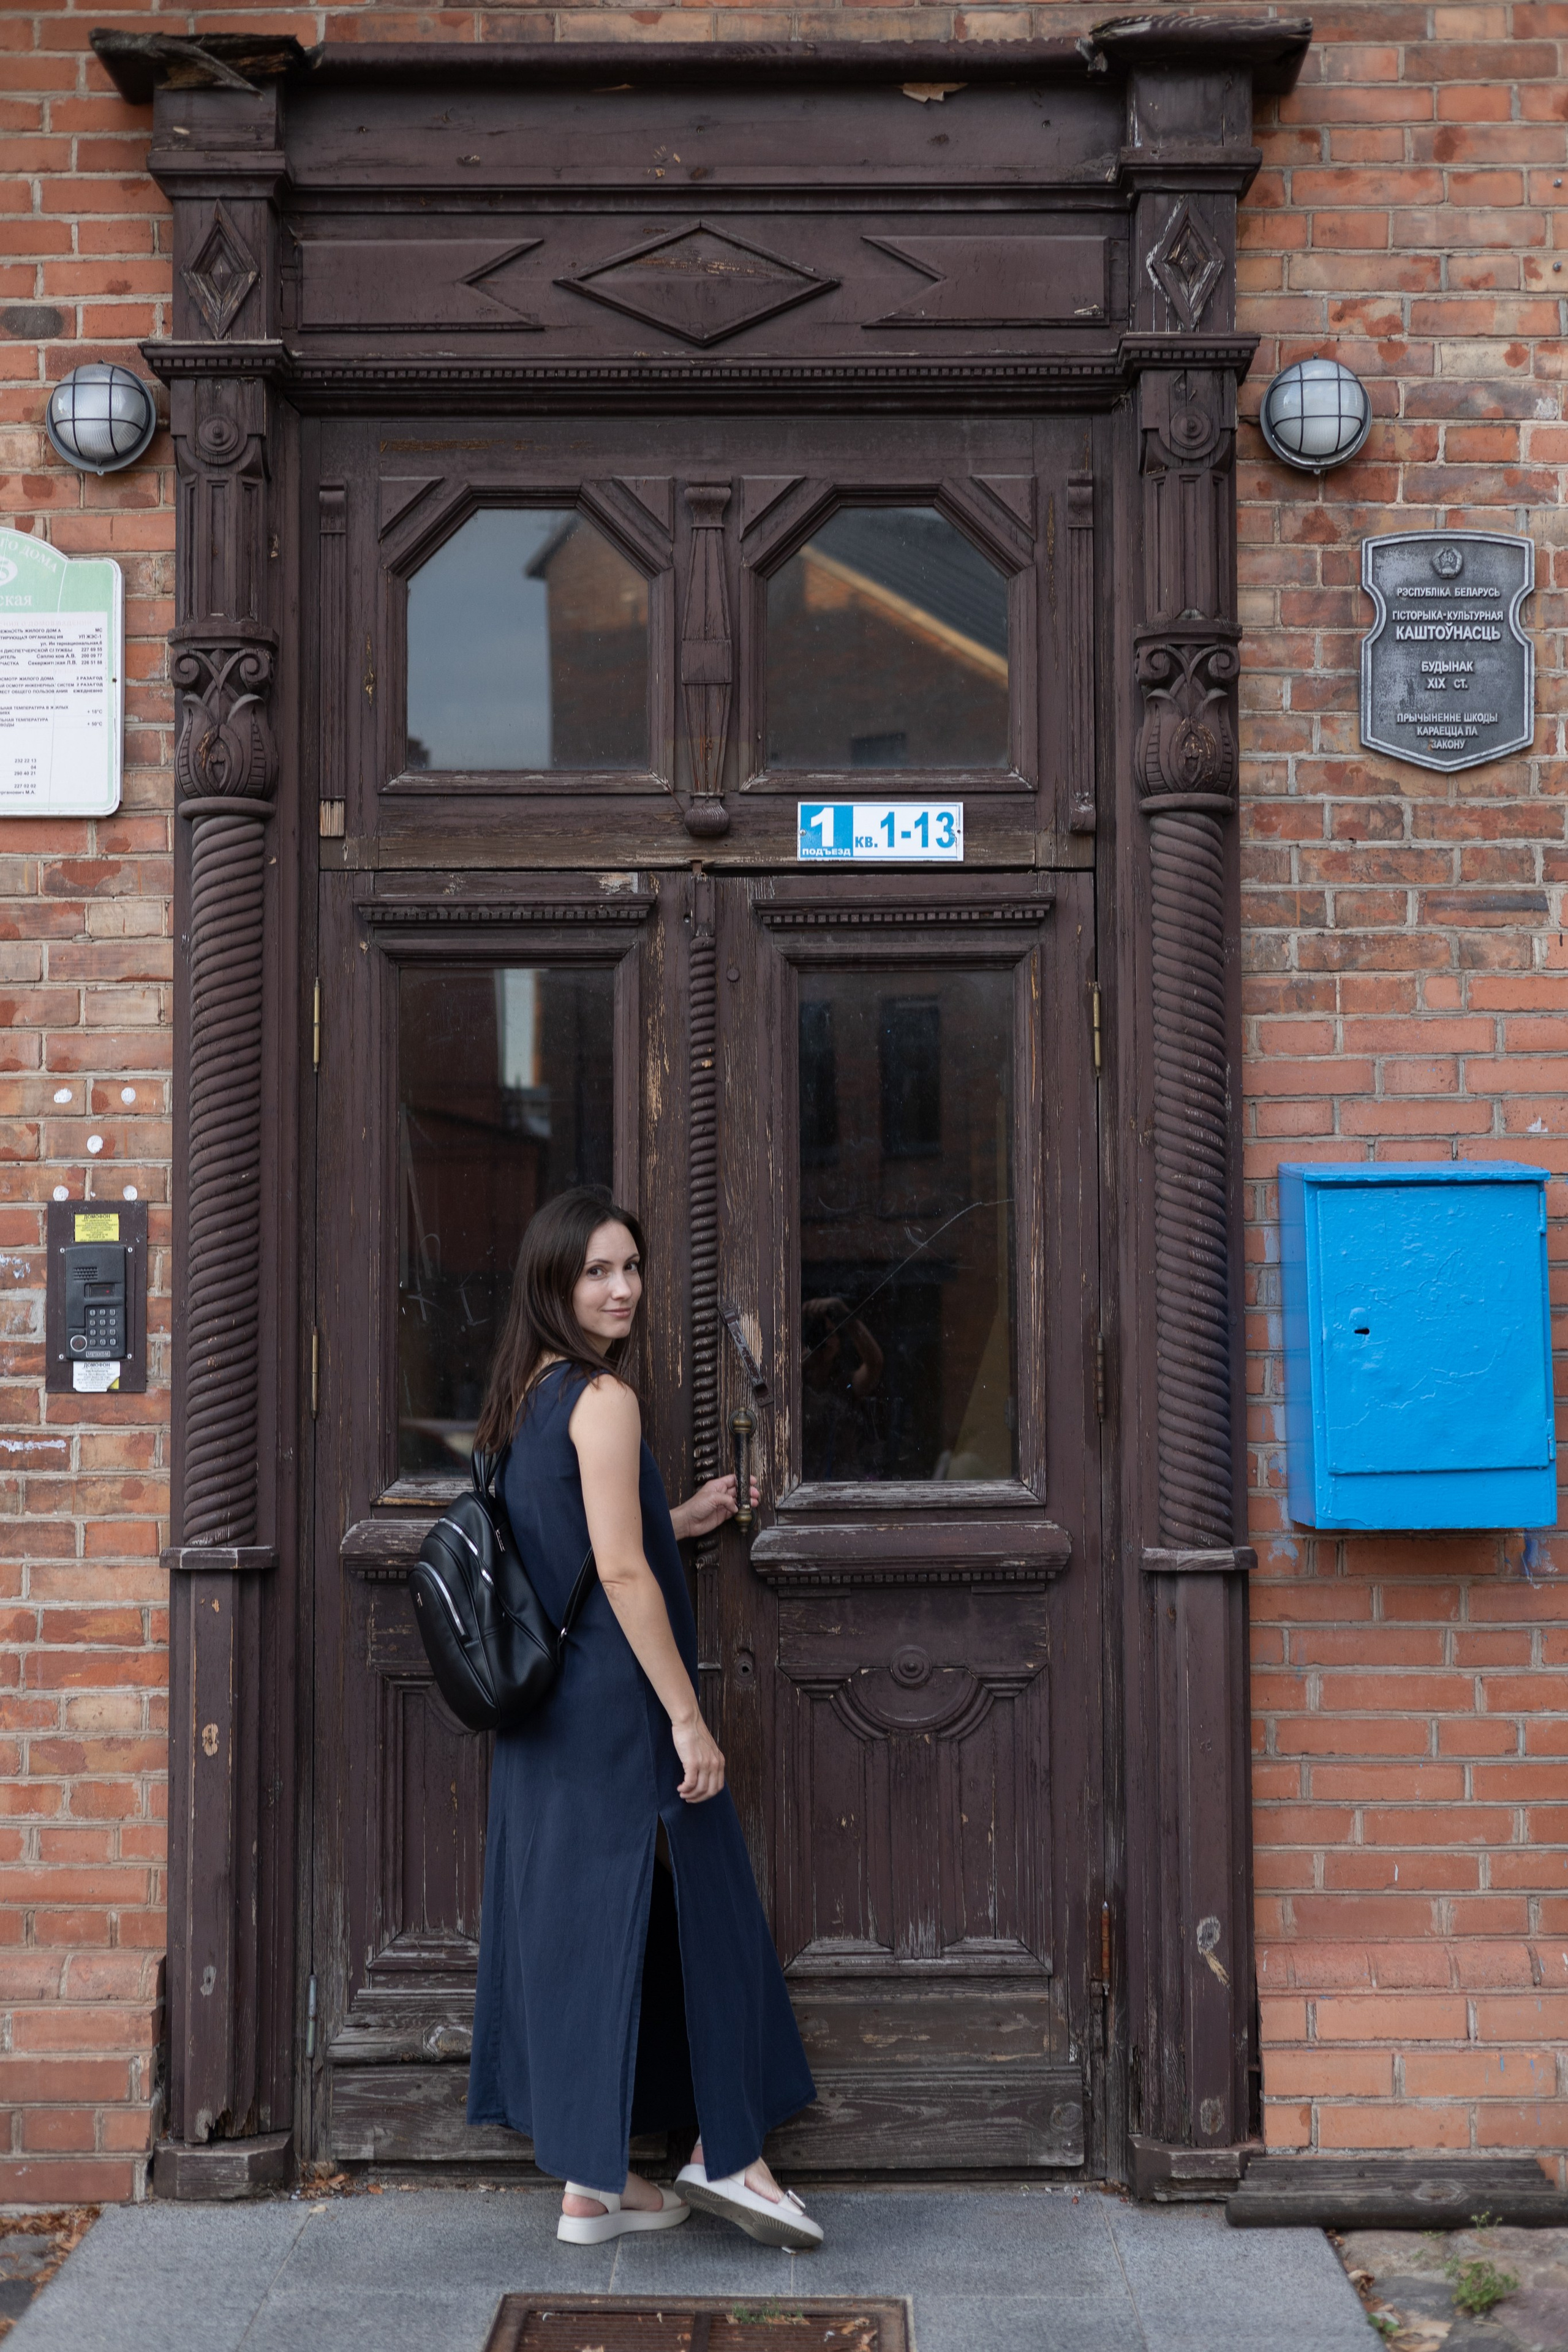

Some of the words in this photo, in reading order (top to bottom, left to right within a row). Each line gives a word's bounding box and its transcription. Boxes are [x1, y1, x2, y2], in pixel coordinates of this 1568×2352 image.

[19, 544, 57, 573] ДОМА
[1397, 587, 1451, 597] РЭСПУБЛІКА
[1455, 587, 1501, 597] БЕЛАРУСЬ
[1392, 611, 1504, 621] ГІСТОРЫКА-КУЛЬТУРНАЯ
[1396, 622, 1501, 641] КАШТОЎНАСЦЬ
[1422, 661, 1474, 674] БУДЫНАК
[1397, 713, 1461, 723] ПРЫЧЫНЕННЕ
[1464, 712, 1498, 724] ШКОДЫ
[1417, 726, 1464, 736] КАРАЕЦЦА
[1465, 726, 1478, 736] ПА
[1431, 739, 1466, 750] ЗАКОНУ
[810, 807, 834, 847] 1
[880, 812, 955, 848] 1-13
